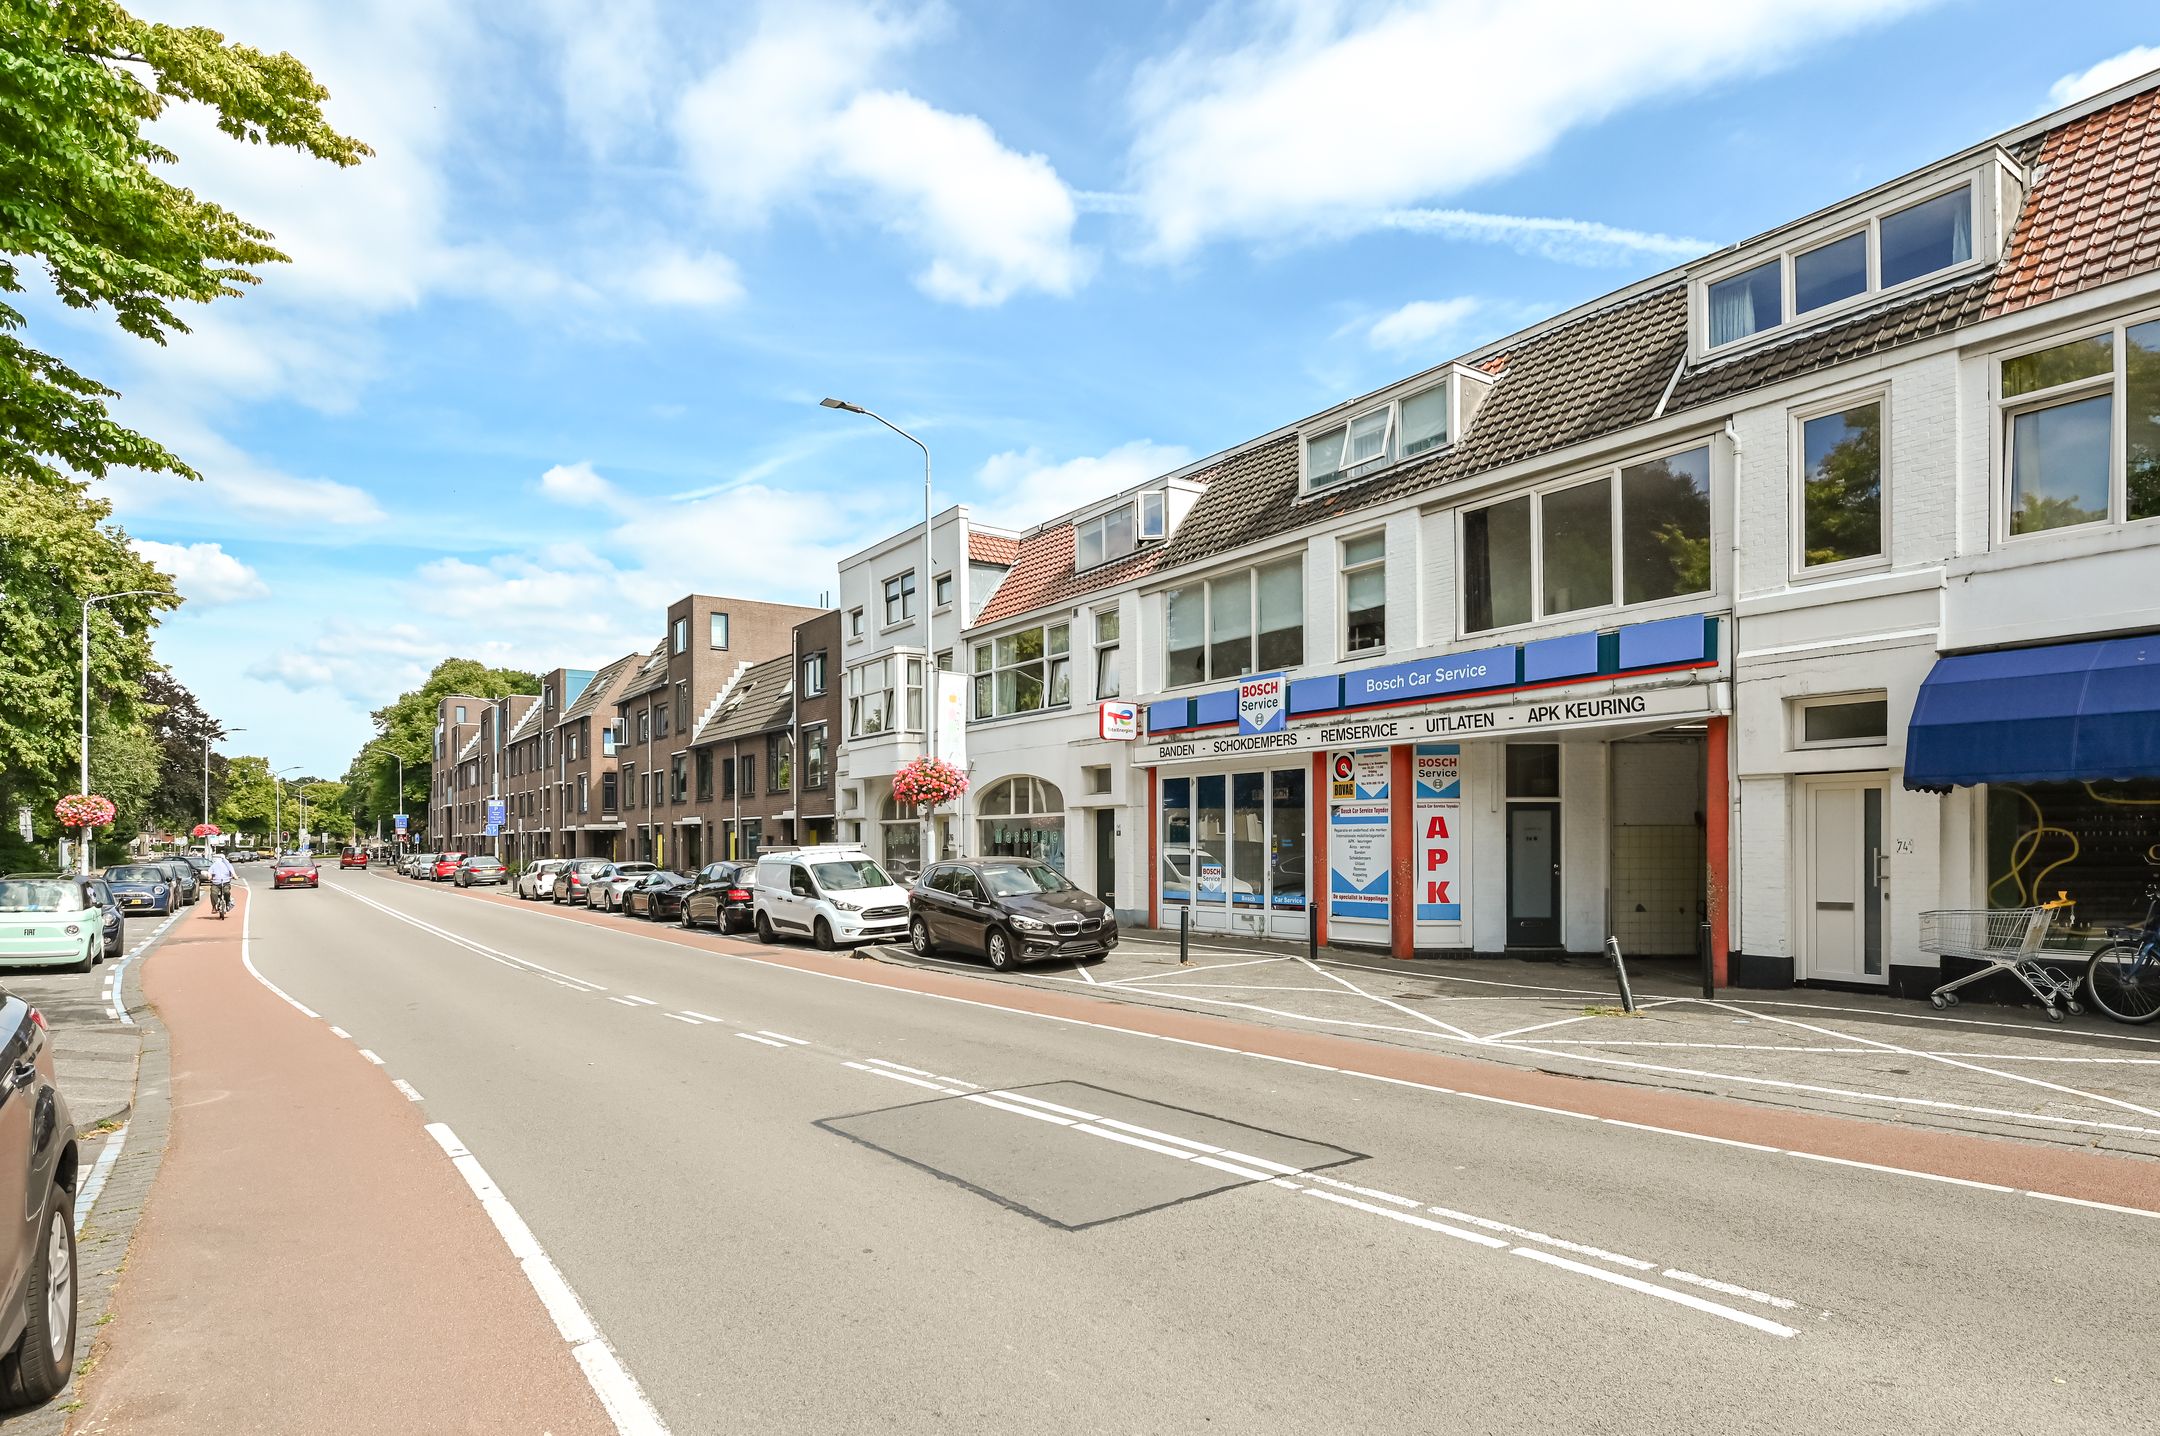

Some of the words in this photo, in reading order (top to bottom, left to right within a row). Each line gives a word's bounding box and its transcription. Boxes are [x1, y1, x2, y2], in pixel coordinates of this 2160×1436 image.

[1366, 675, 1404, 692] Bosch
[1408, 672, 1432, 686] Car
[1436, 664, 1486, 682] Service
[1242, 682, 1278, 698] BOSCH
[1242, 698, 1278, 712] Service
[1160, 744, 1195, 758] BANDEN
[1213, 732, 1297, 753] SCHOKDEMPERS
[1321, 722, 1398, 742] REMSERVICE
[1426, 712, 1494, 732] UITLATEN
[1528, 705, 1561, 722] APK
[1566, 696, 1646, 719] KEURING
[1418, 758, 1457, 768] BOSCH
[1418, 768, 1458, 778] Service
